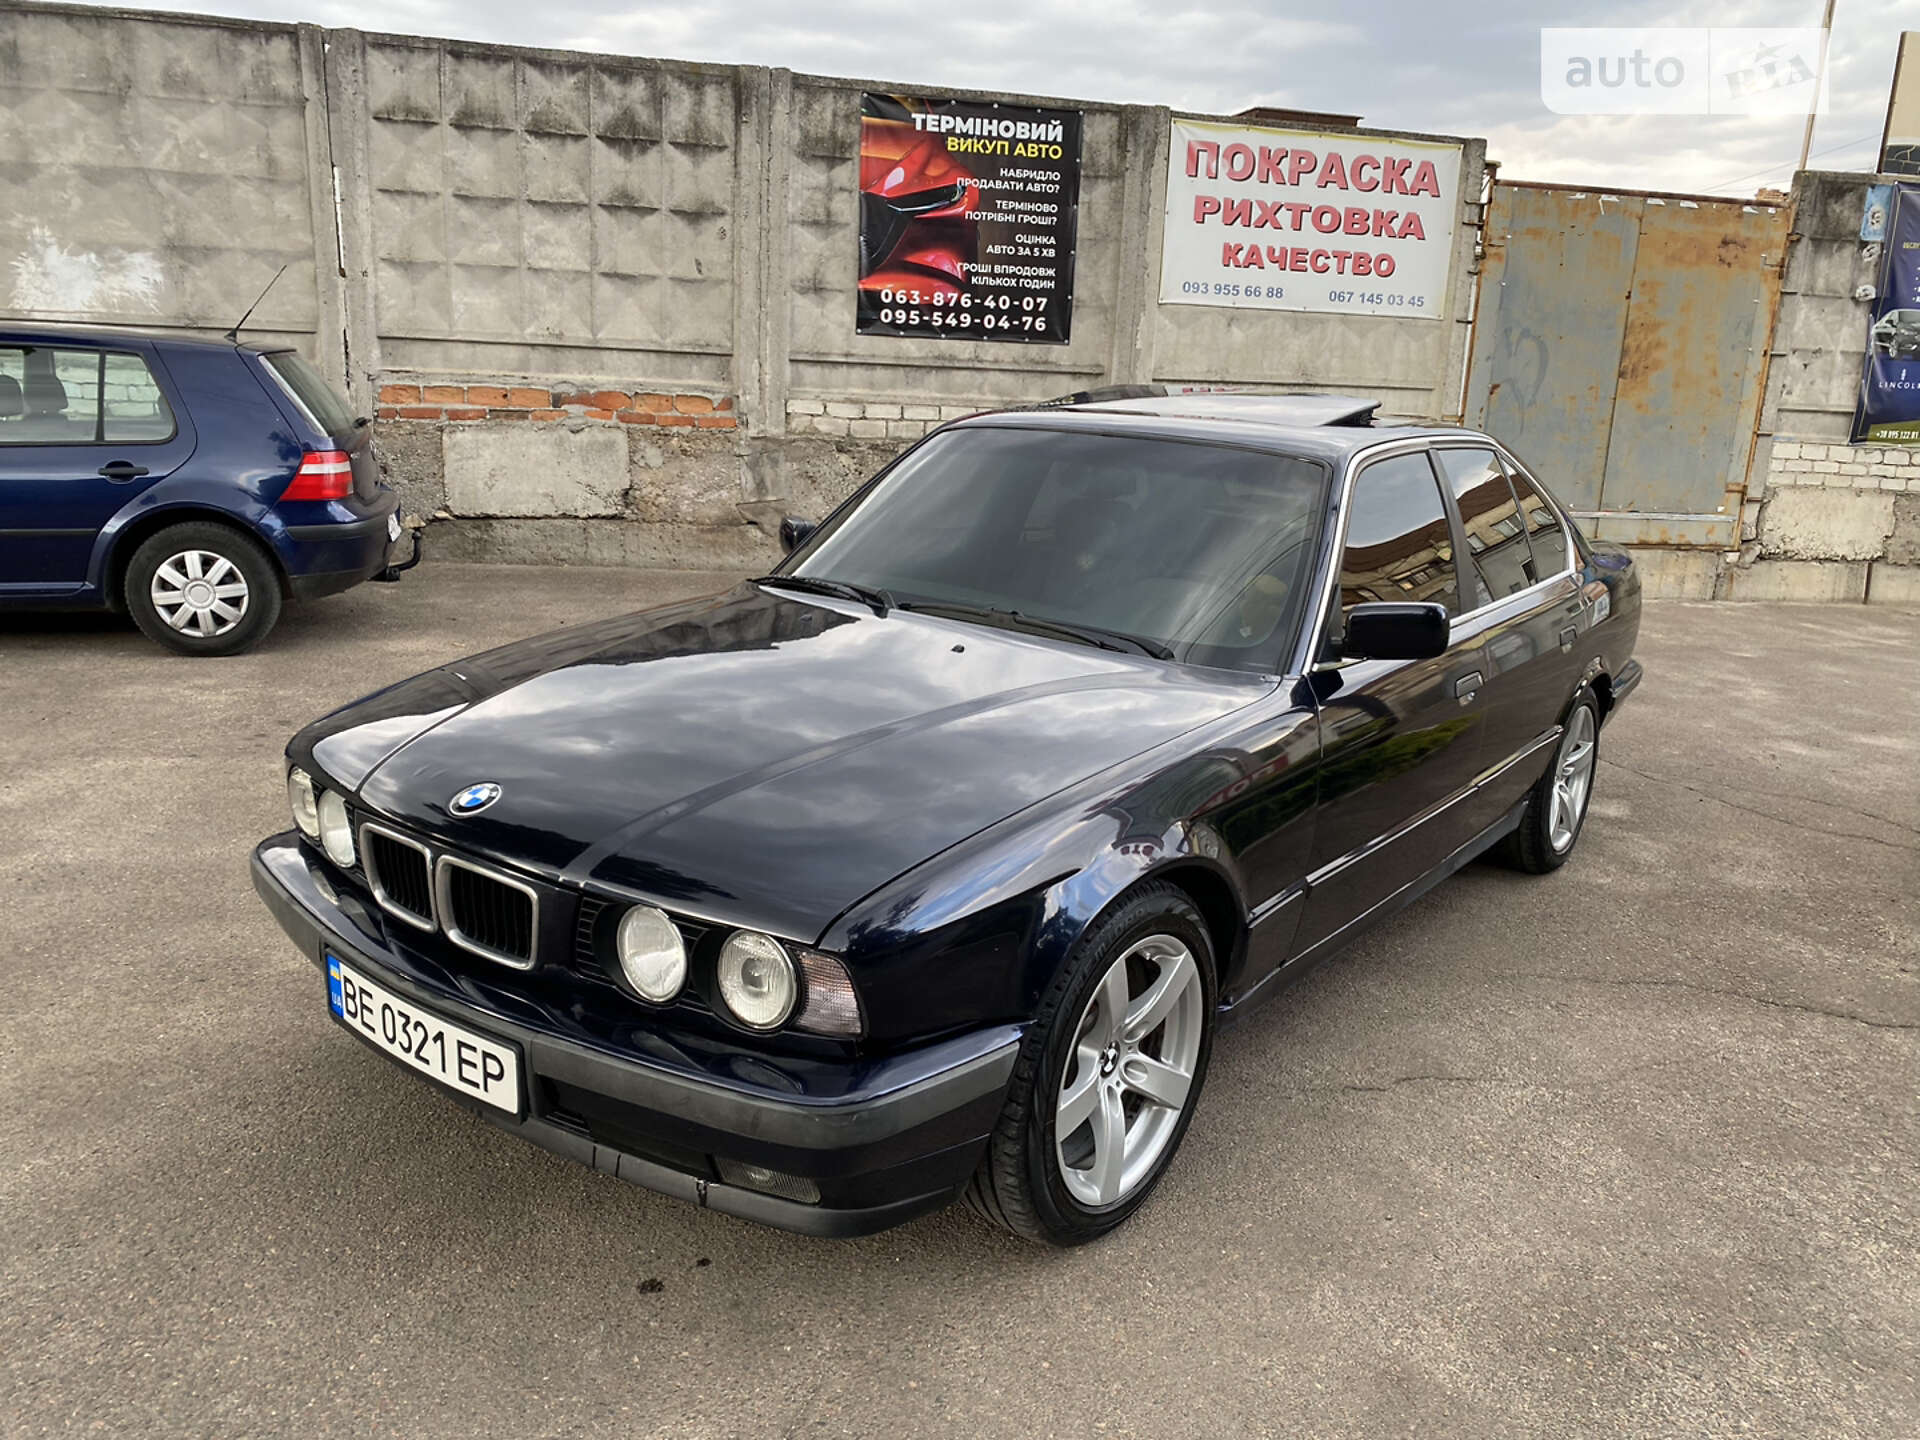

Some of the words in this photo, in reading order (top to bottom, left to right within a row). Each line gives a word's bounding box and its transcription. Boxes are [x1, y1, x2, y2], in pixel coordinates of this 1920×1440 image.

[911, 113, 1064, 142] ТЕРМІНОВИЙ
[947, 137, 1009, 157] ВИКУП
[1013, 143, 1063, 159] АВТО
[1000, 168, 1061, 181] НАБРИДЛО
[1185, 140, 1441, 198] ПОКРАСКА
[956, 177, 1023, 191] ПРОДАВАТИ
[1026, 182, 1060, 193] АВТО?
[995, 200, 1058, 213] ТЕРМІНОВО
[964, 211, 1016, 223] ПОТРІБНІ
[1017, 214, 1058, 225] ГРОШІ?
[1193, 195, 1427, 241] РИХТОВКА
[1015, 234, 1056, 246] ОЦІНКА
[986, 245, 1015, 256] АВТО
[1017, 247, 1032, 256] ЗА
[1033, 247, 1040, 257] 5
[1041, 248, 1056, 257] ХВ
[1222, 242, 1396, 277] КАЧЕСТВО
[956, 262, 992, 274] ГРОШІ
[994, 265, 1056, 278] ВПРОДОВЖ
[971, 275, 1017, 288] КІЛЬКОХ
[1019, 278, 1055, 289] ГОДИН
[1182, 281, 1209, 295] 093
[1214, 283, 1240, 297] 955
[1244, 285, 1262, 298] 66
[1266, 287, 1284, 299] 88
[880, 288, 1048, 311] 063-876-40-07
[1329, 290, 1354, 303] 067
[1359, 292, 1383, 305] 145
[1387, 294, 1405, 306] 03
[1408, 295, 1425, 307] 45
[879, 309, 1047, 331] 095-549-04-76
[342, 974, 376, 1035] BE
[381, 1002, 447, 1074] 0321
[456, 1039, 505, 1093] EP
